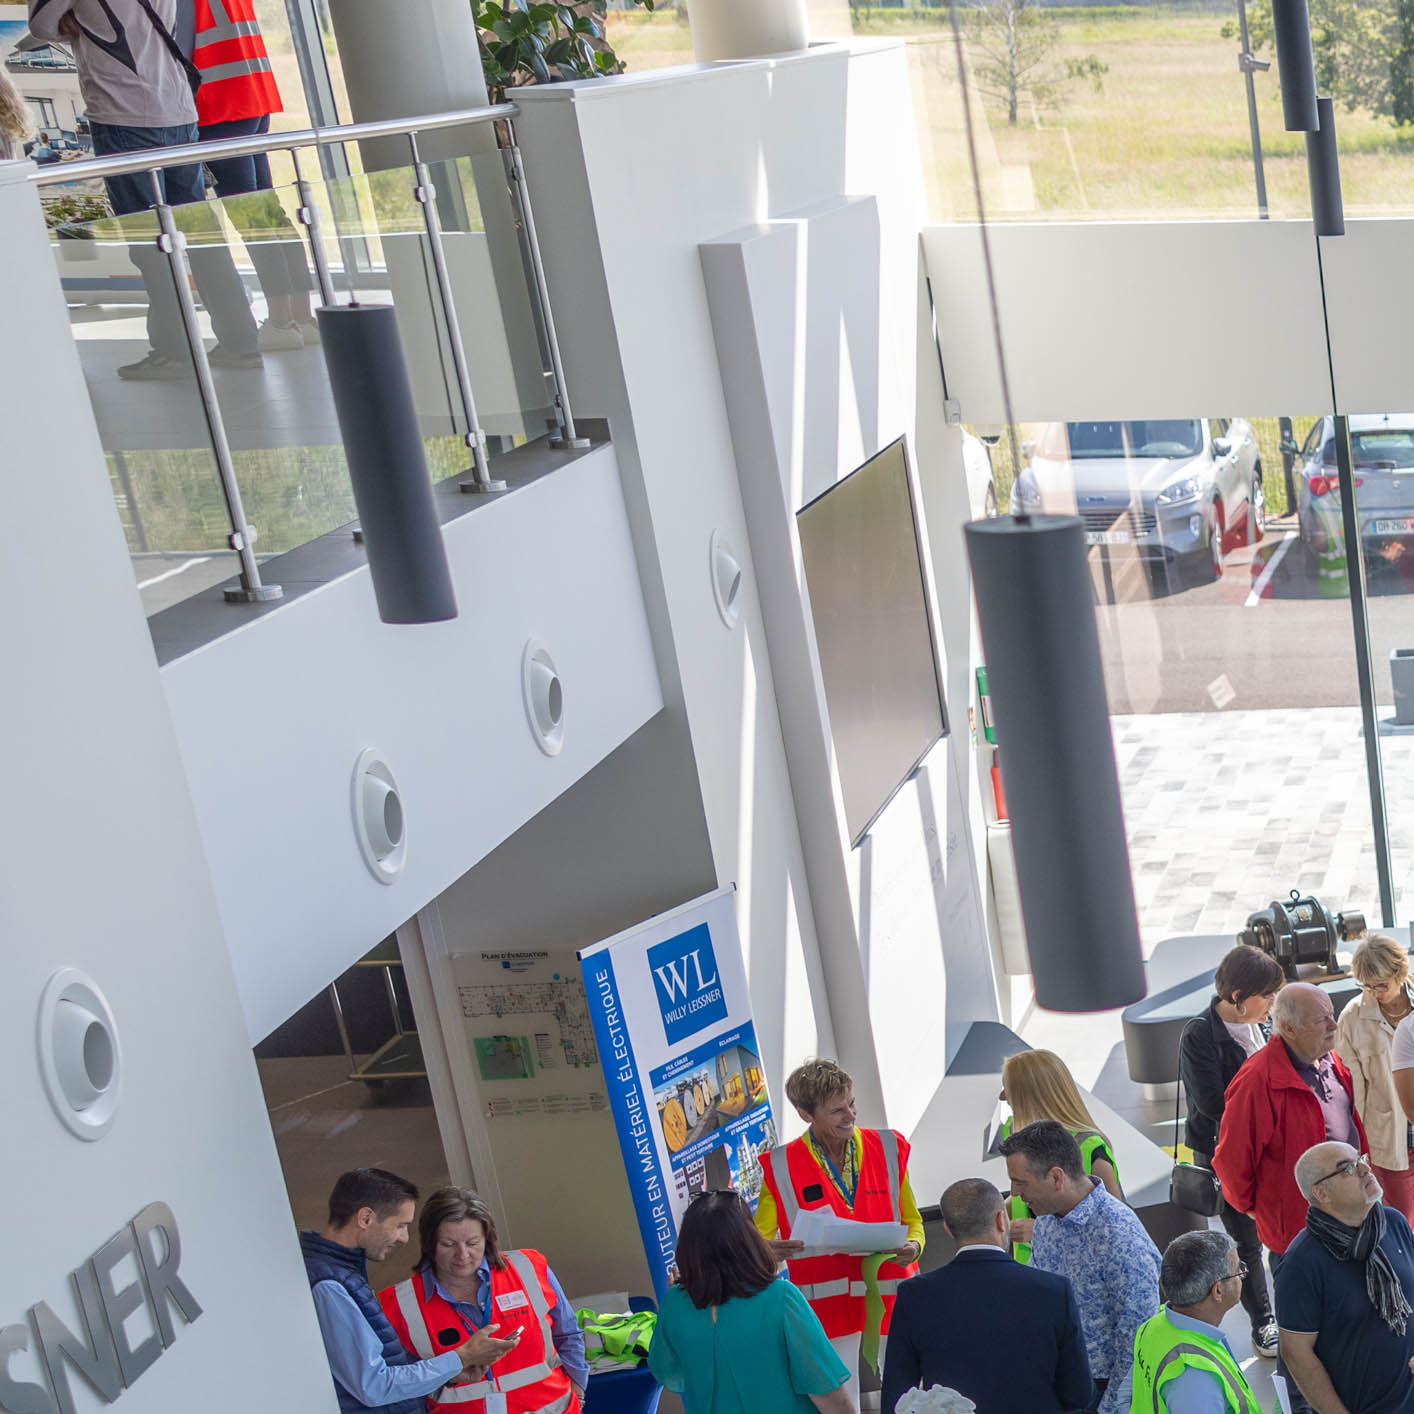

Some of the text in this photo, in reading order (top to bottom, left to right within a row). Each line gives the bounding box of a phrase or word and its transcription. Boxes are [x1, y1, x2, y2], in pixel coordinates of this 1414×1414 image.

[653, 948, 717, 1005] WL
[664, 988, 722, 1025] WILLY LEISSNER
[595, 968, 678, 1276] BUTEUR EN MATÉRIEL ÉLECTRIQUE
